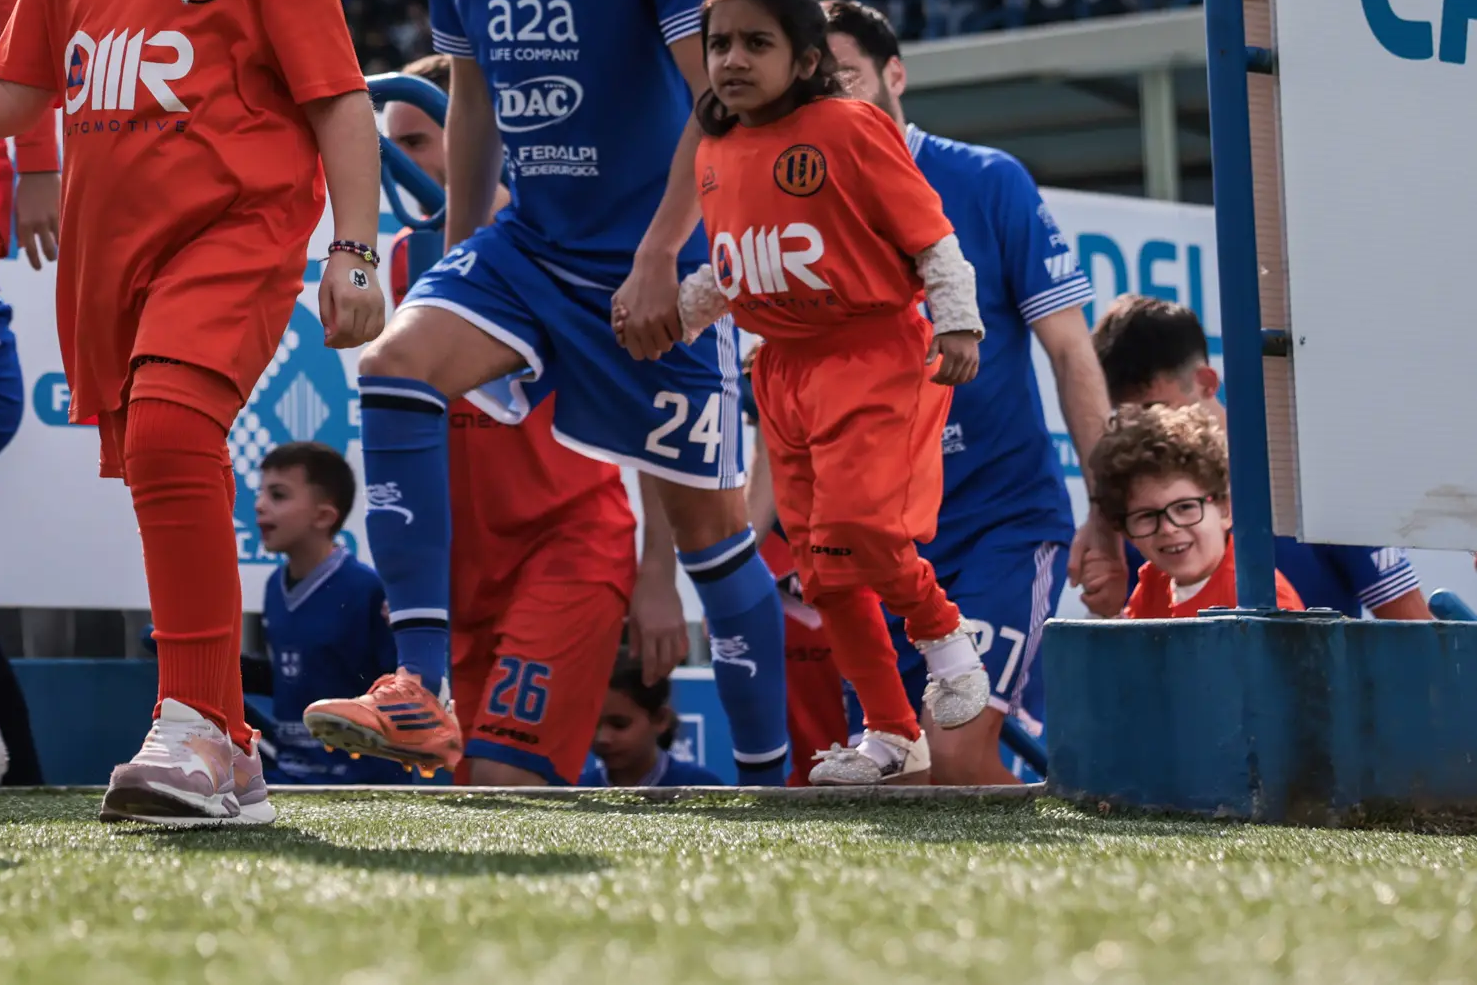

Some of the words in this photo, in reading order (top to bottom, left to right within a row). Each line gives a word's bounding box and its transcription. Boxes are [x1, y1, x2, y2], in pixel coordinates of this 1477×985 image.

[490, 48, 511, 61] LIFE
[514, 48, 580, 62] COMPANY
[64, 27, 194, 115] OMR
[499, 88, 569, 117] DAC
[66, 119, 186, 137] UTOMOTIVE
[518, 145, 598, 162] FERALPI
[520, 164, 599, 177] SIDERURGICA
[645, 391, 722, 464] 24
[486, 655, 552, 726] 26
